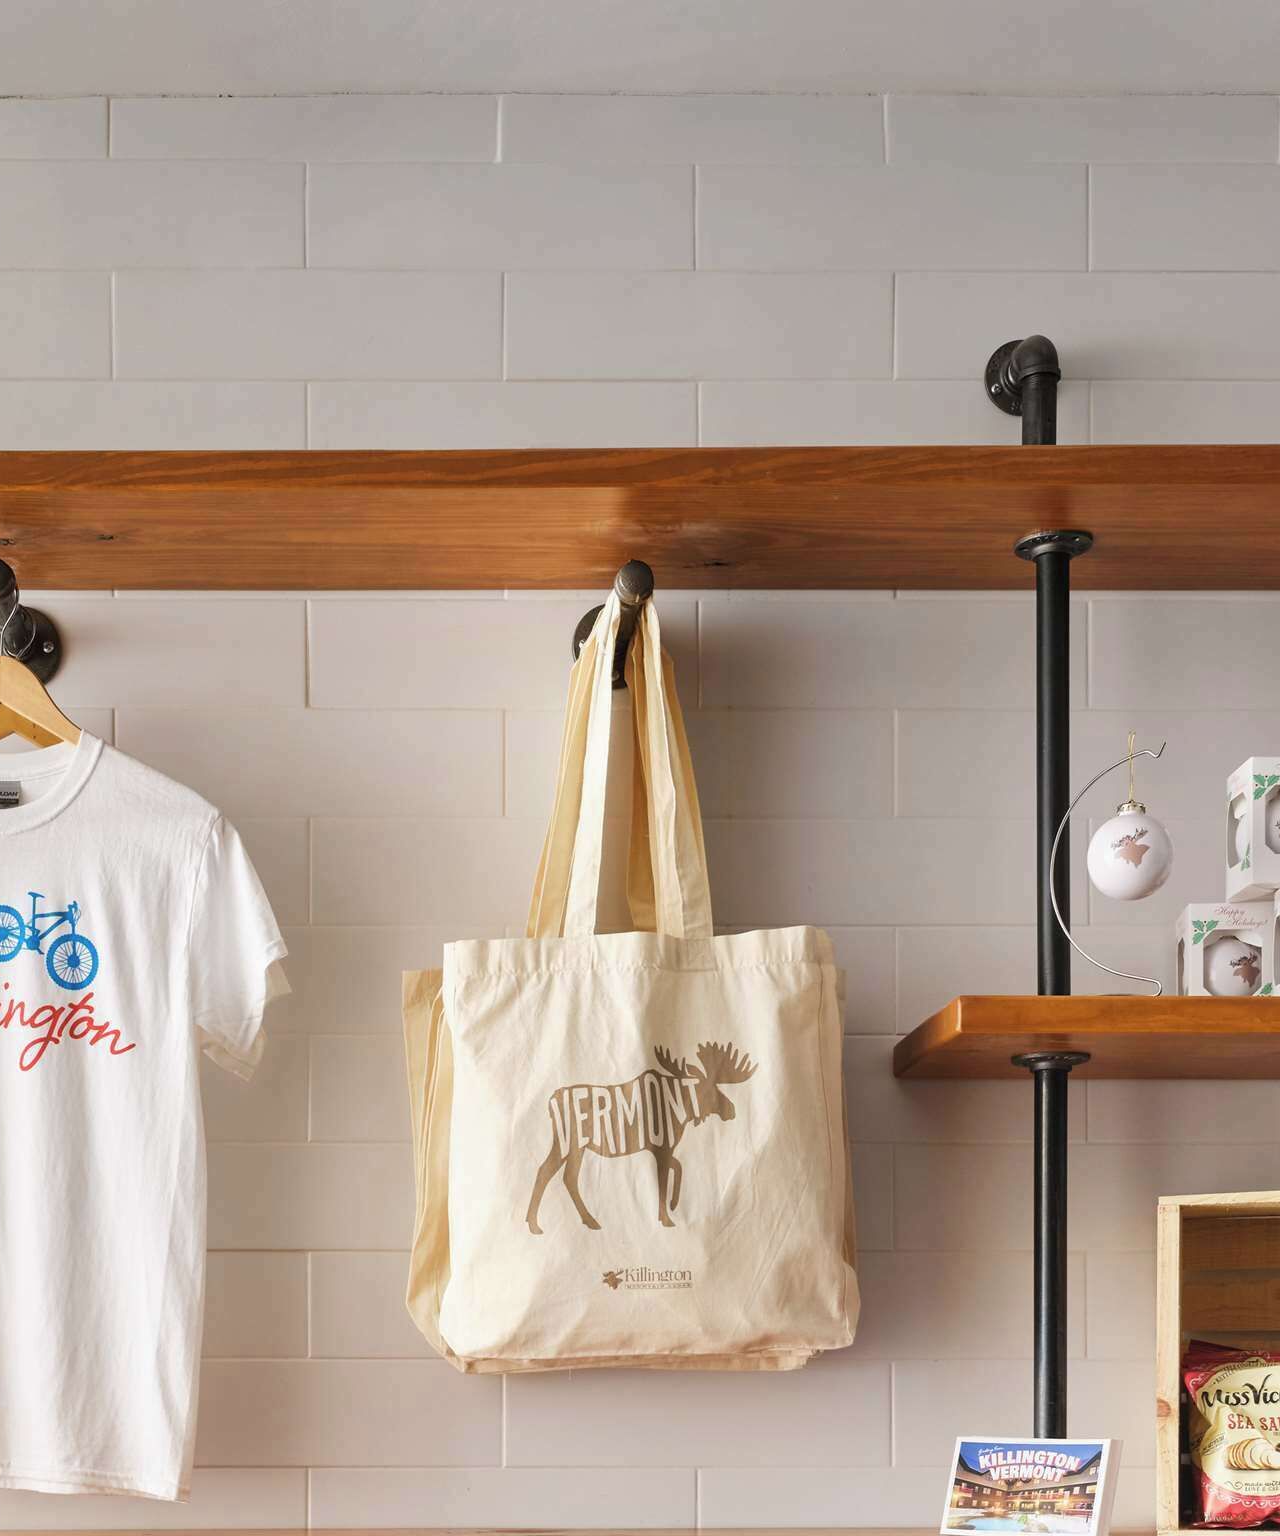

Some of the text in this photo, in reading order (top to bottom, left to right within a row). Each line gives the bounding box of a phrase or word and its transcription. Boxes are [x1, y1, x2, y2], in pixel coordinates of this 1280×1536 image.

[1215, 905, 1247, 920] Happy
[549, 1073, 702, 1158] VERMONT
[624, 1265, 693, 1283] Killington
[1201, 1388, 1250, 1409] Miss
[1228, 1413, 1256, 1430] SEA
[979, 1449, 1081, 1473] KILLINGTON
[989, 1464, 1068, 1483] VERMONT
